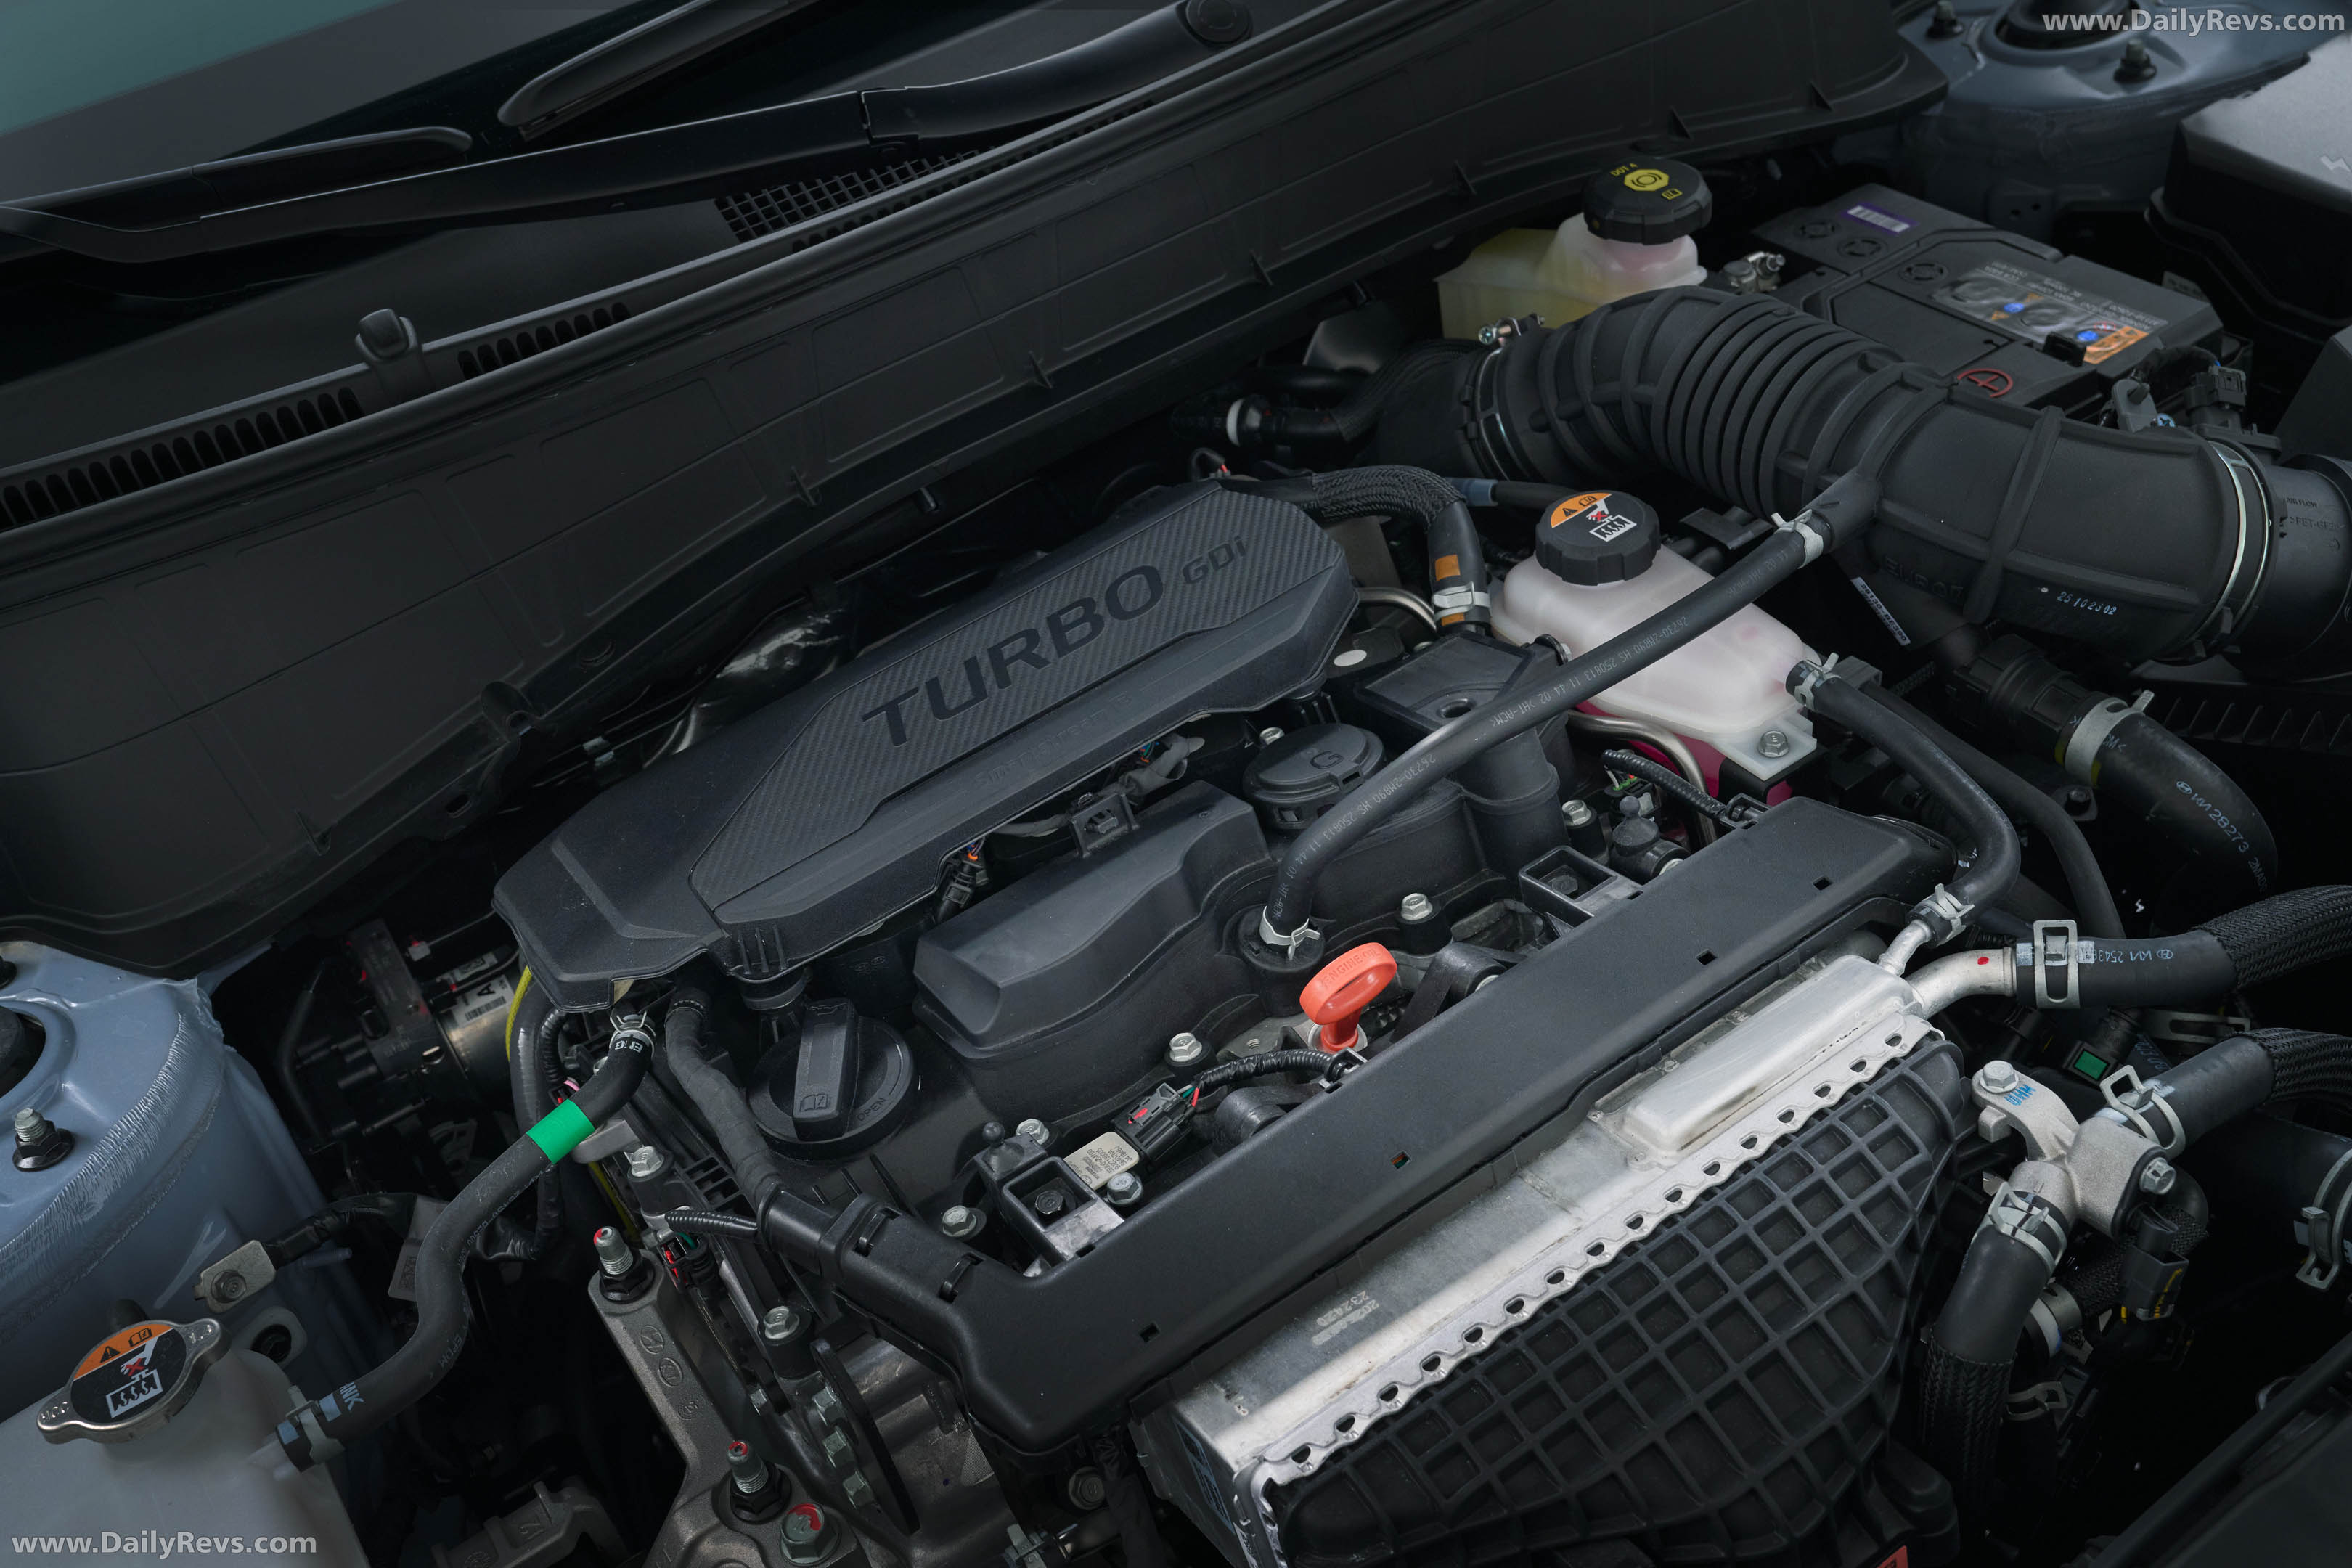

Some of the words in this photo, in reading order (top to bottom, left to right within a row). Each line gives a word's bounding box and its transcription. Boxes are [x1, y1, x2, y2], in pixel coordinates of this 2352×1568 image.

[862, 564, 1164, 748] TURBO
[2209, 809, 2250, 853] 28273
[857, 1097, 886, 1122] OPEN
